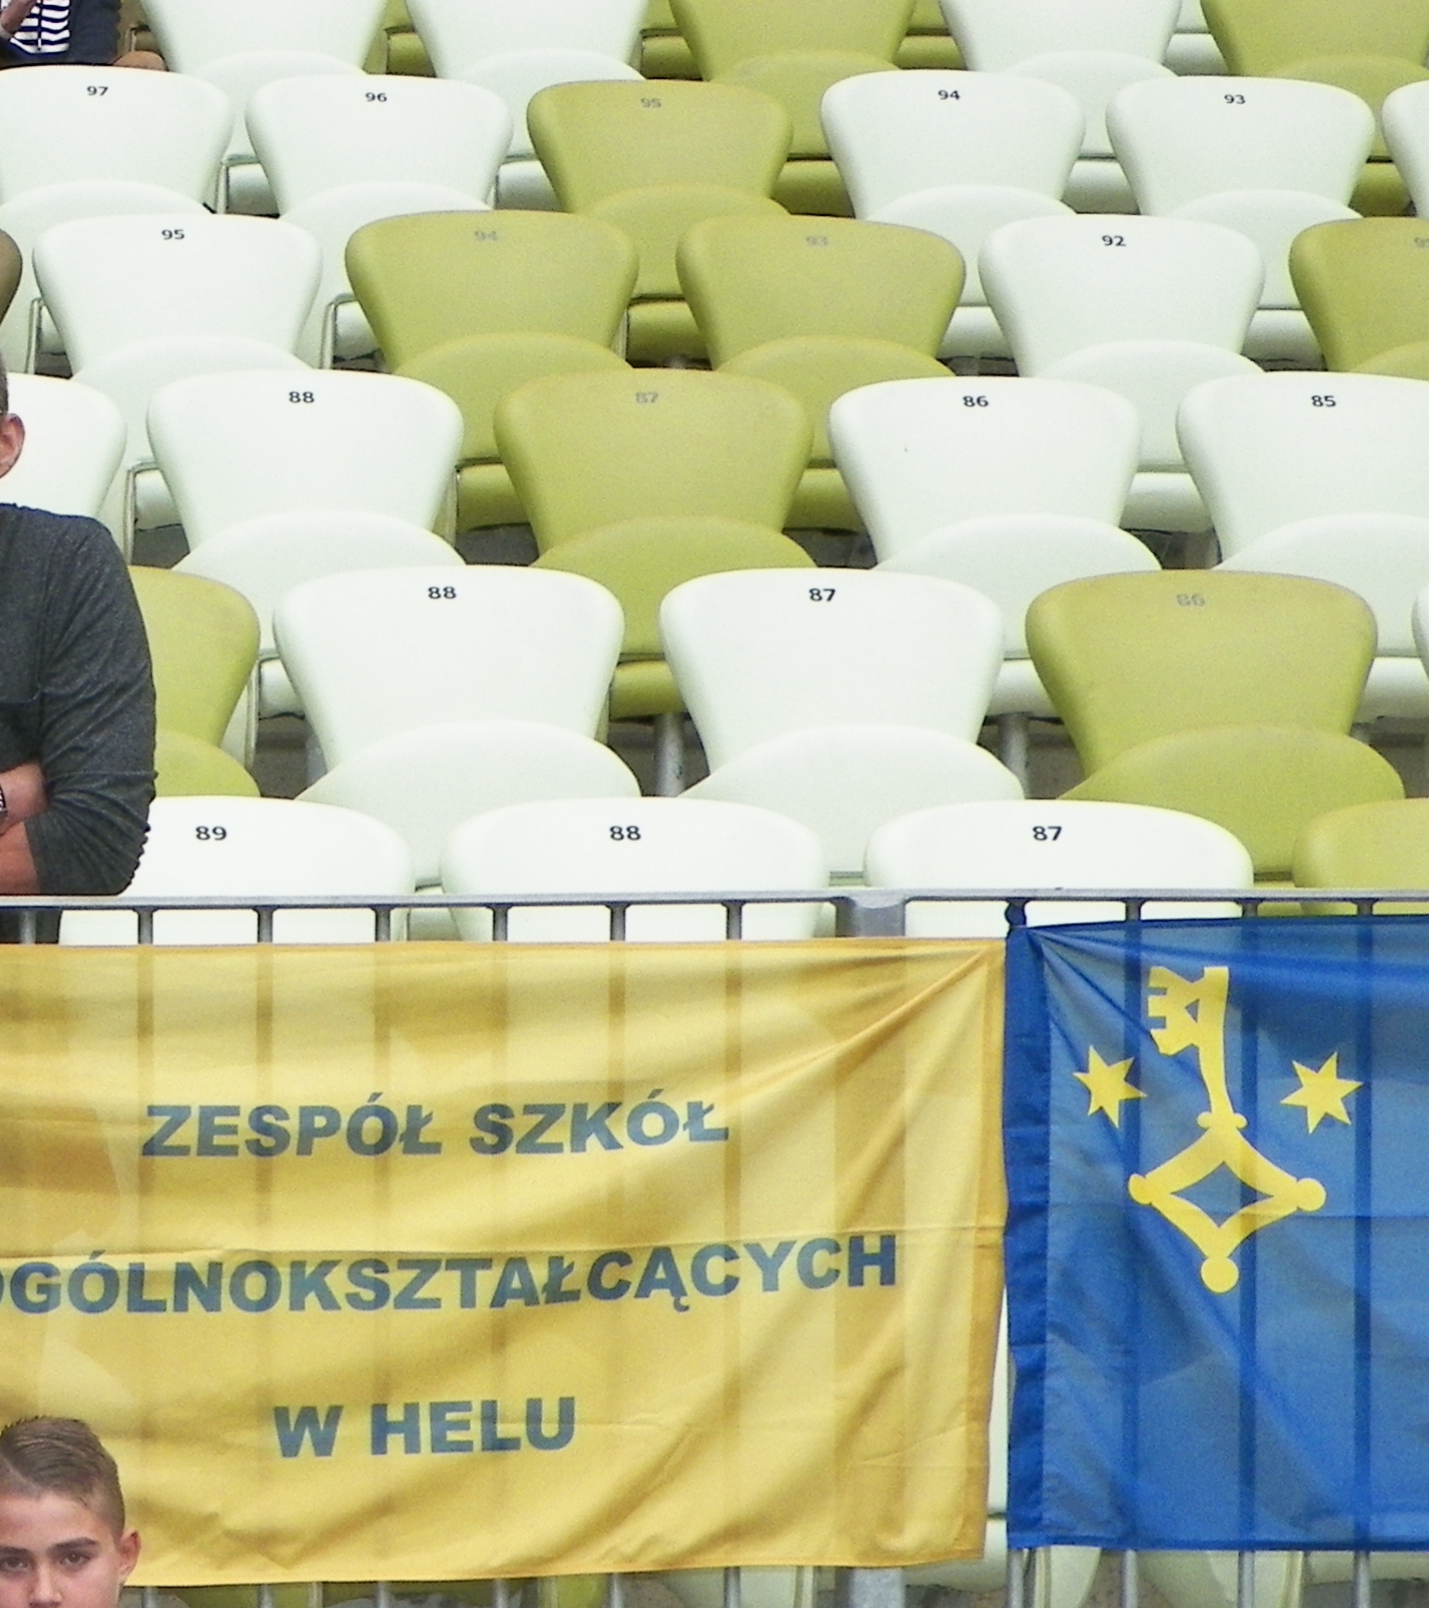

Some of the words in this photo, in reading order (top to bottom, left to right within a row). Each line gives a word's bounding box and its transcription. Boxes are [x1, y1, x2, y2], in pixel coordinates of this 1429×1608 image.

[86, 85, 109, 97] 97
[364, 91, 388, 103] 96
[937, 89, 961, 101] 94
[639, 96, 663, 108] 95
[1223, 93, 1247, 105] 93
[160, 228, 186, 241] 95
[1101, 234, 1126, 247] 92
[288, 390, 316, 404] 88
[962, 395, 990, 408] 86
[1310, 394, 1337, 408] 85
[427, 585, 457, 600] 88
[808, 587, 837, 603] 87
[195, 825, 228, 842] 89
[609, 825, 642, 842] 88
[1031, 825, 1063, 842] 87
[140, 1092, 443, 1159] ZESPÓŁ
[467, 1088, 731, 1157] SZKÓŁ
[272, 1404, 344, 1459] W
[369, 1396, 577, 1457] HELU
